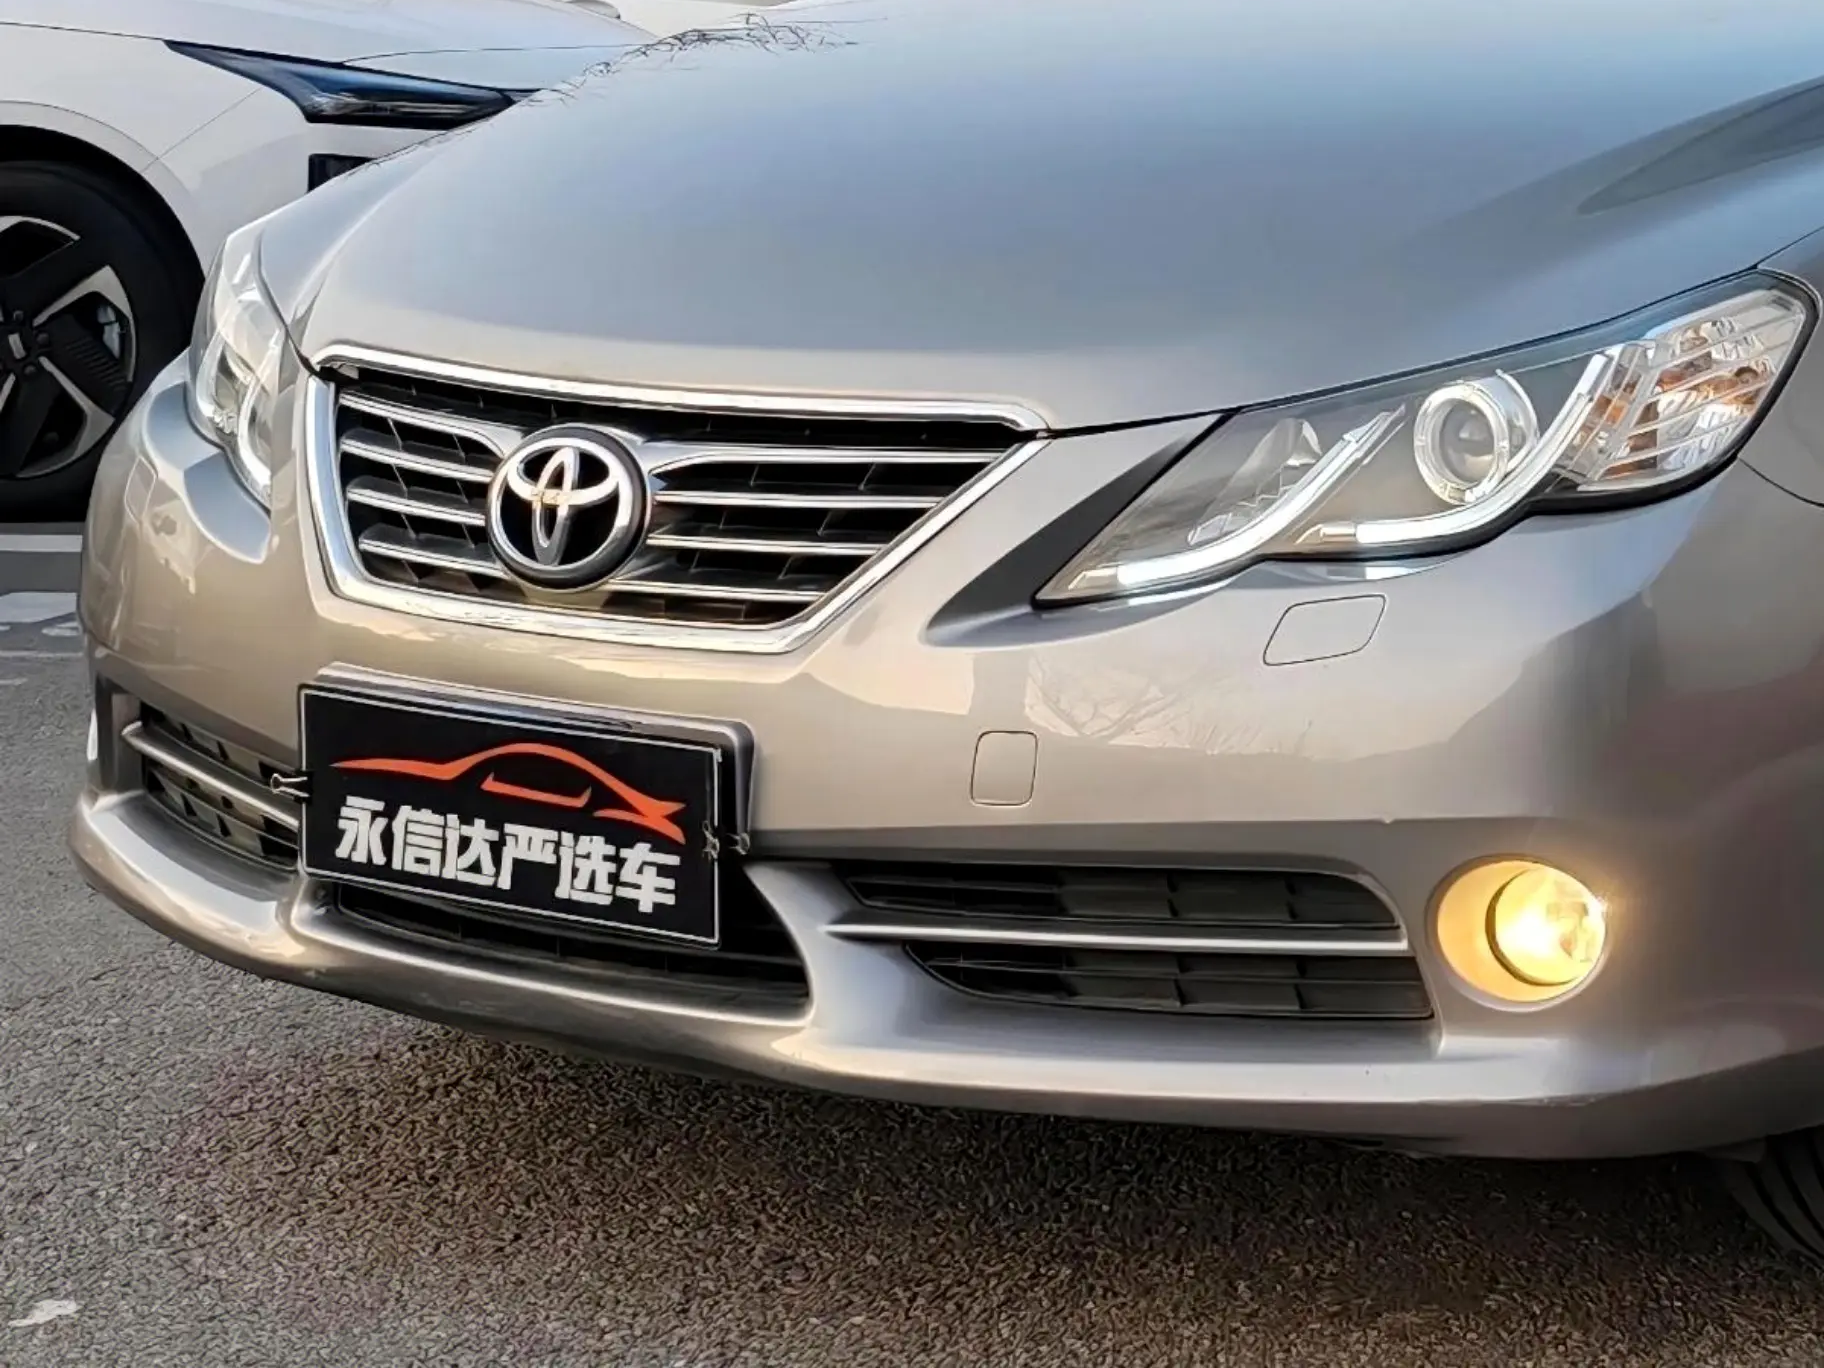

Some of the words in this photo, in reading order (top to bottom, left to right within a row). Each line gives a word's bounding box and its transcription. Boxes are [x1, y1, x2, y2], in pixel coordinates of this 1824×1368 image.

[334, 795, 681, 912] 永信达严选车
